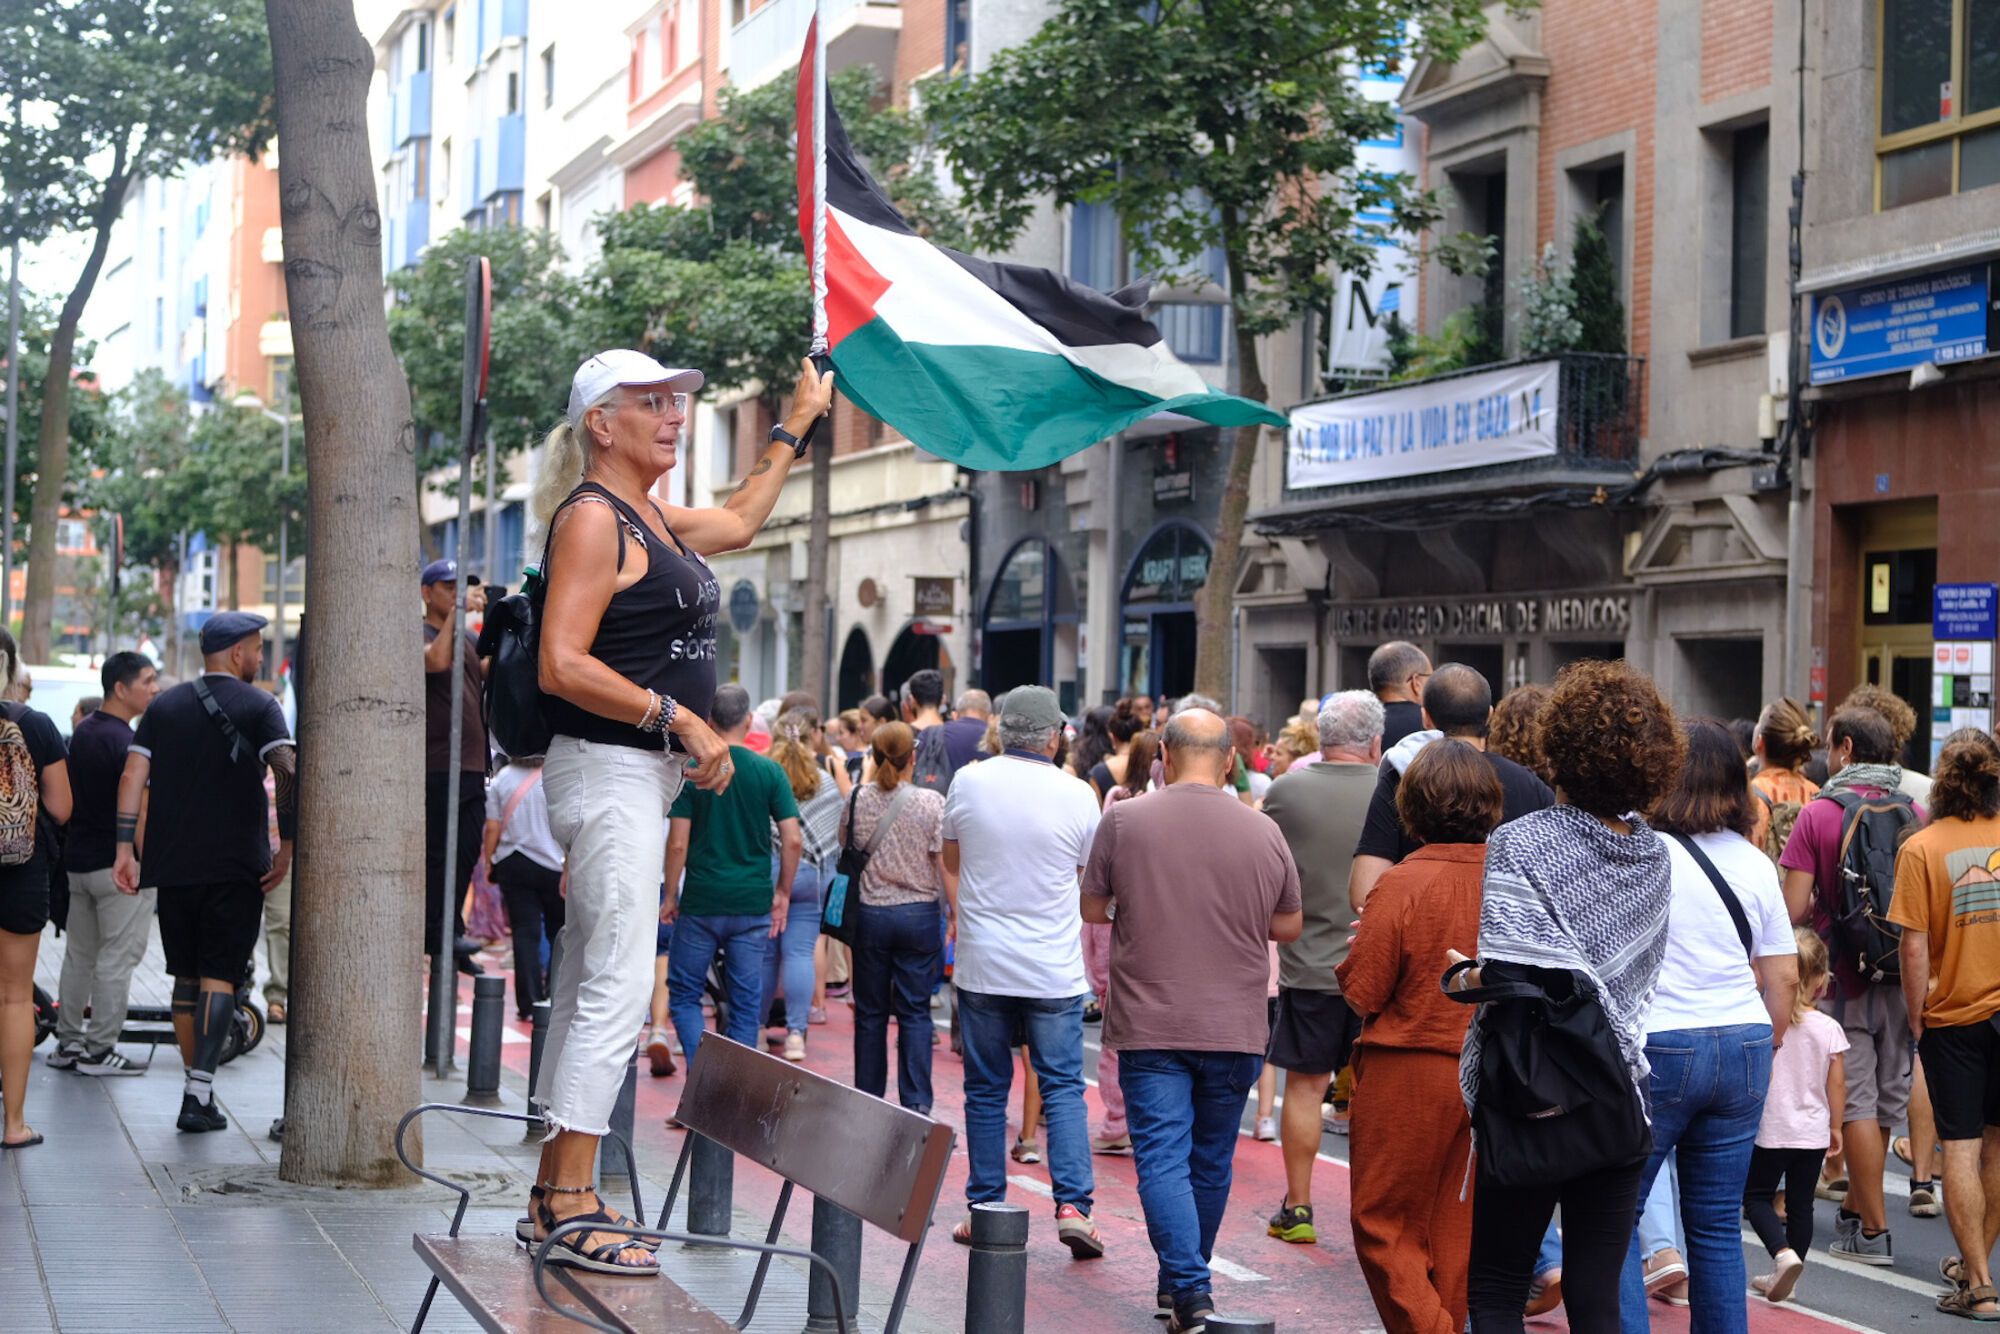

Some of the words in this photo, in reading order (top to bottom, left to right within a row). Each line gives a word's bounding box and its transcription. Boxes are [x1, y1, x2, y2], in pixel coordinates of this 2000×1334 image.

[1319, 422, 1340, 463] POR
[1345, 419, 1358, 461] LA
[1363, 416, 1384, 459] PAZ
[1389, 413, 1396, 454] Y
[1401, 410, 1414, 453] LA
[1420, 405, 1447, 448] VIDA
[1454, 401, 1471, 445] EN
[1477, 393, 1510, 440] GAZA
[1382, 604, 1445, 635] COLEGIO
[1452, 601, 1511, 634] OFICIAL
[1516, 599, 1538, 632] DE
